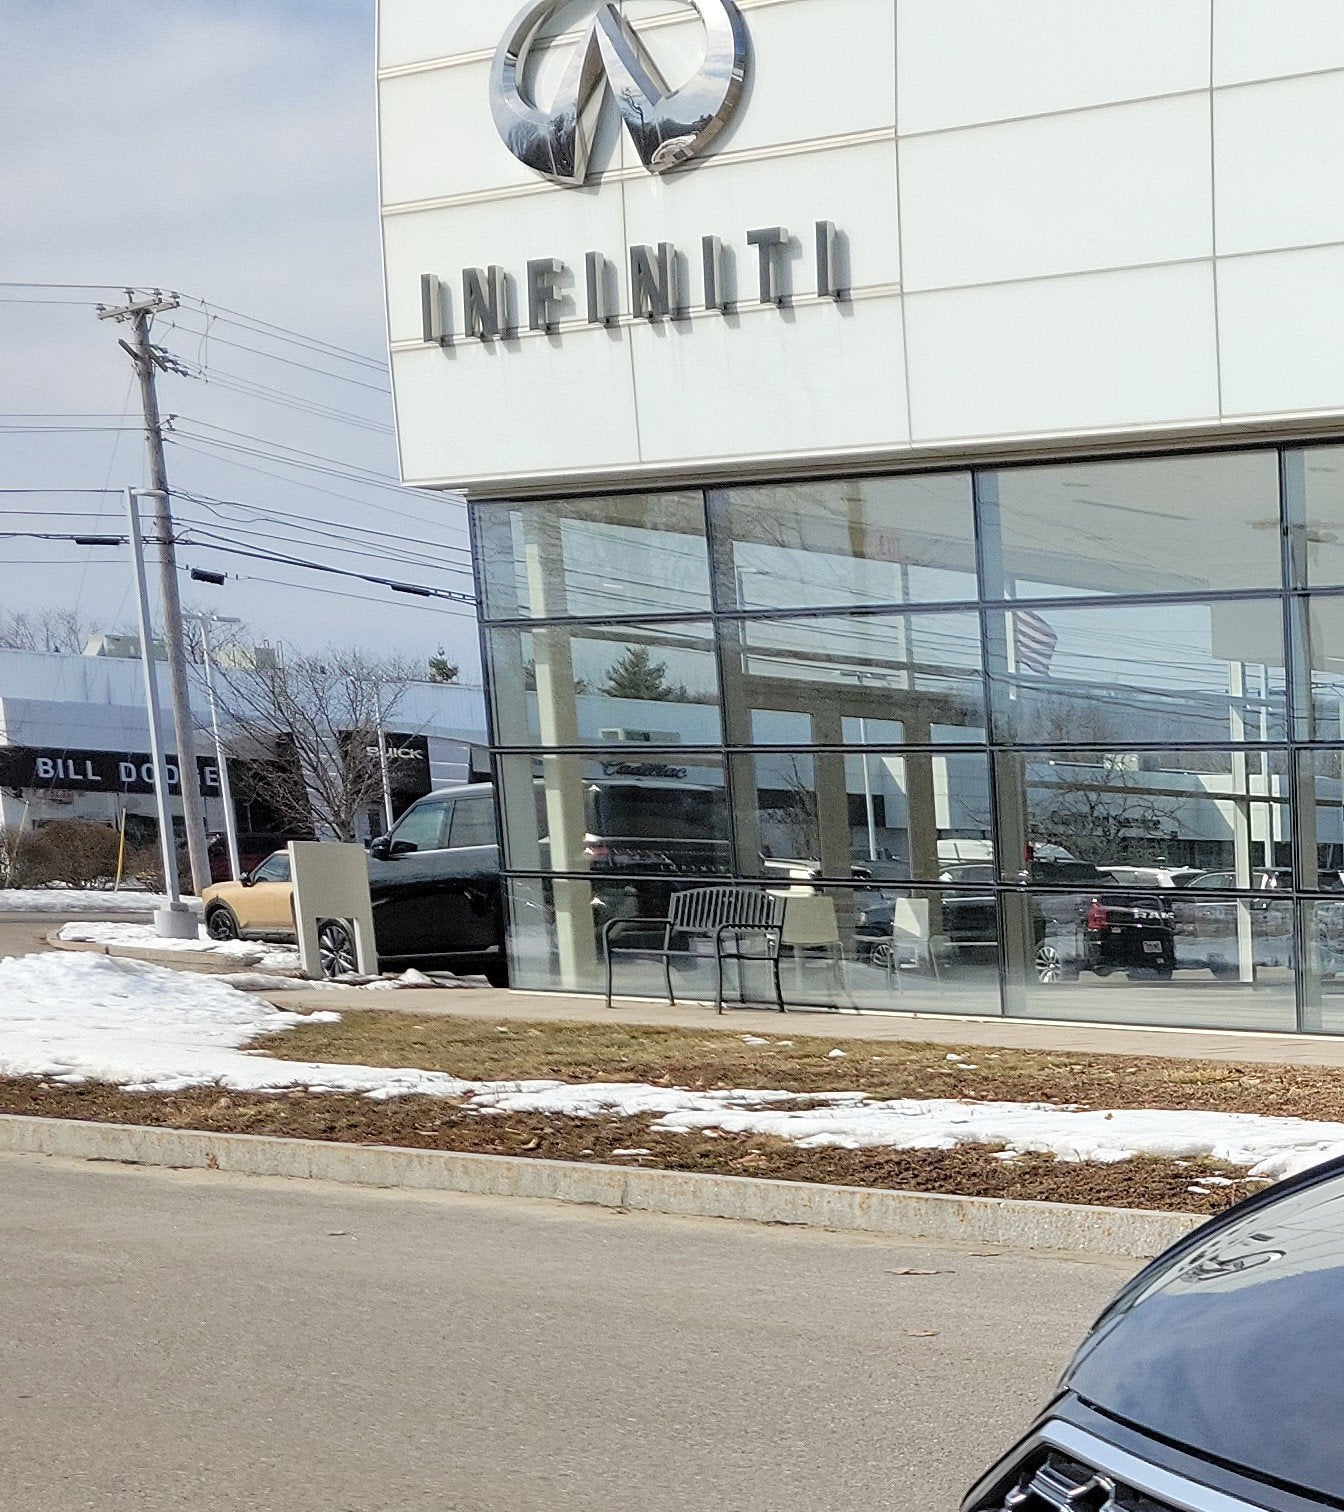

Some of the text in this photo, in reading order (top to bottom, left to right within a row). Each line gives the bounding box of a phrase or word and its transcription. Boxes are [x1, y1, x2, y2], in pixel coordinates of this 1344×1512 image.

[421, 220, 836, 342] INFINITI
[35, 757, 220, 787] BILL DODE
